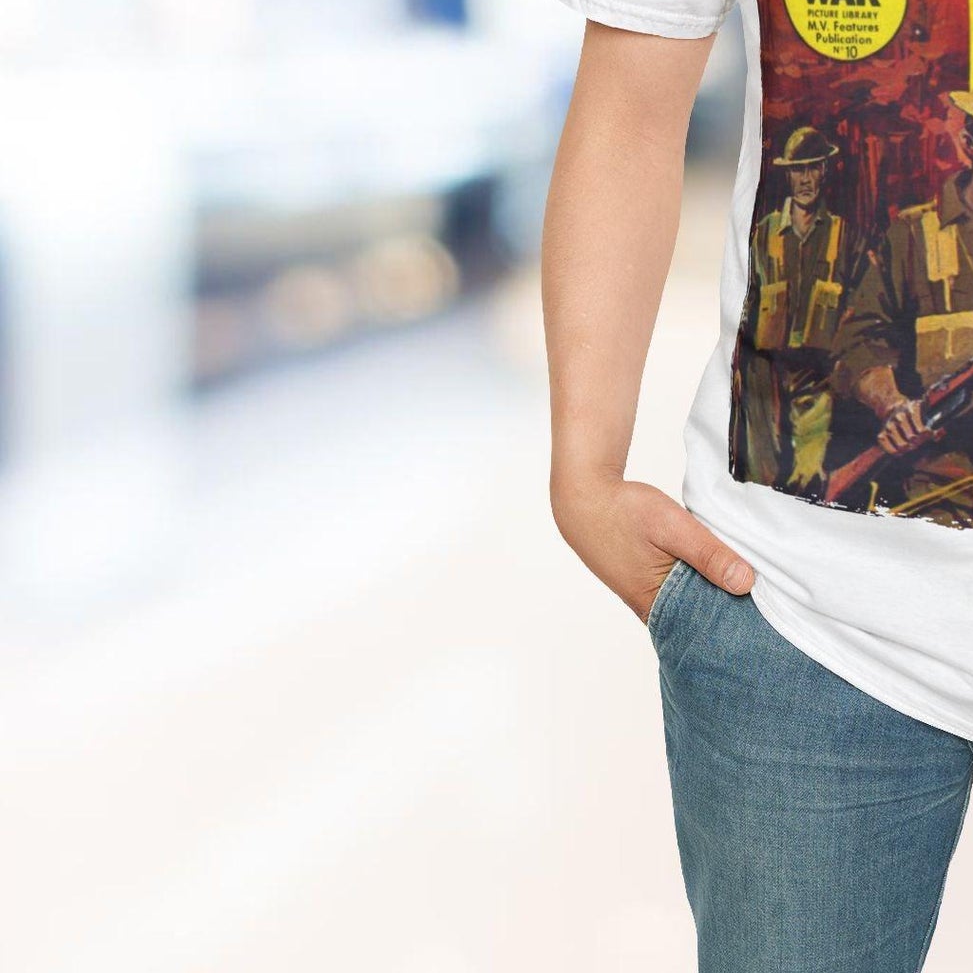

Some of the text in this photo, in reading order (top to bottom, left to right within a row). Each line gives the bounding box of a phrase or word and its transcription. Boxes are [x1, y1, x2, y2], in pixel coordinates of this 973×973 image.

[807, 9, 878, 19] PICTURE LIBRARY
[808, 21, 879, 32] M.V. Features
[816, 32, 872, 44] Publication
[846, 46, 858, 59] 10
